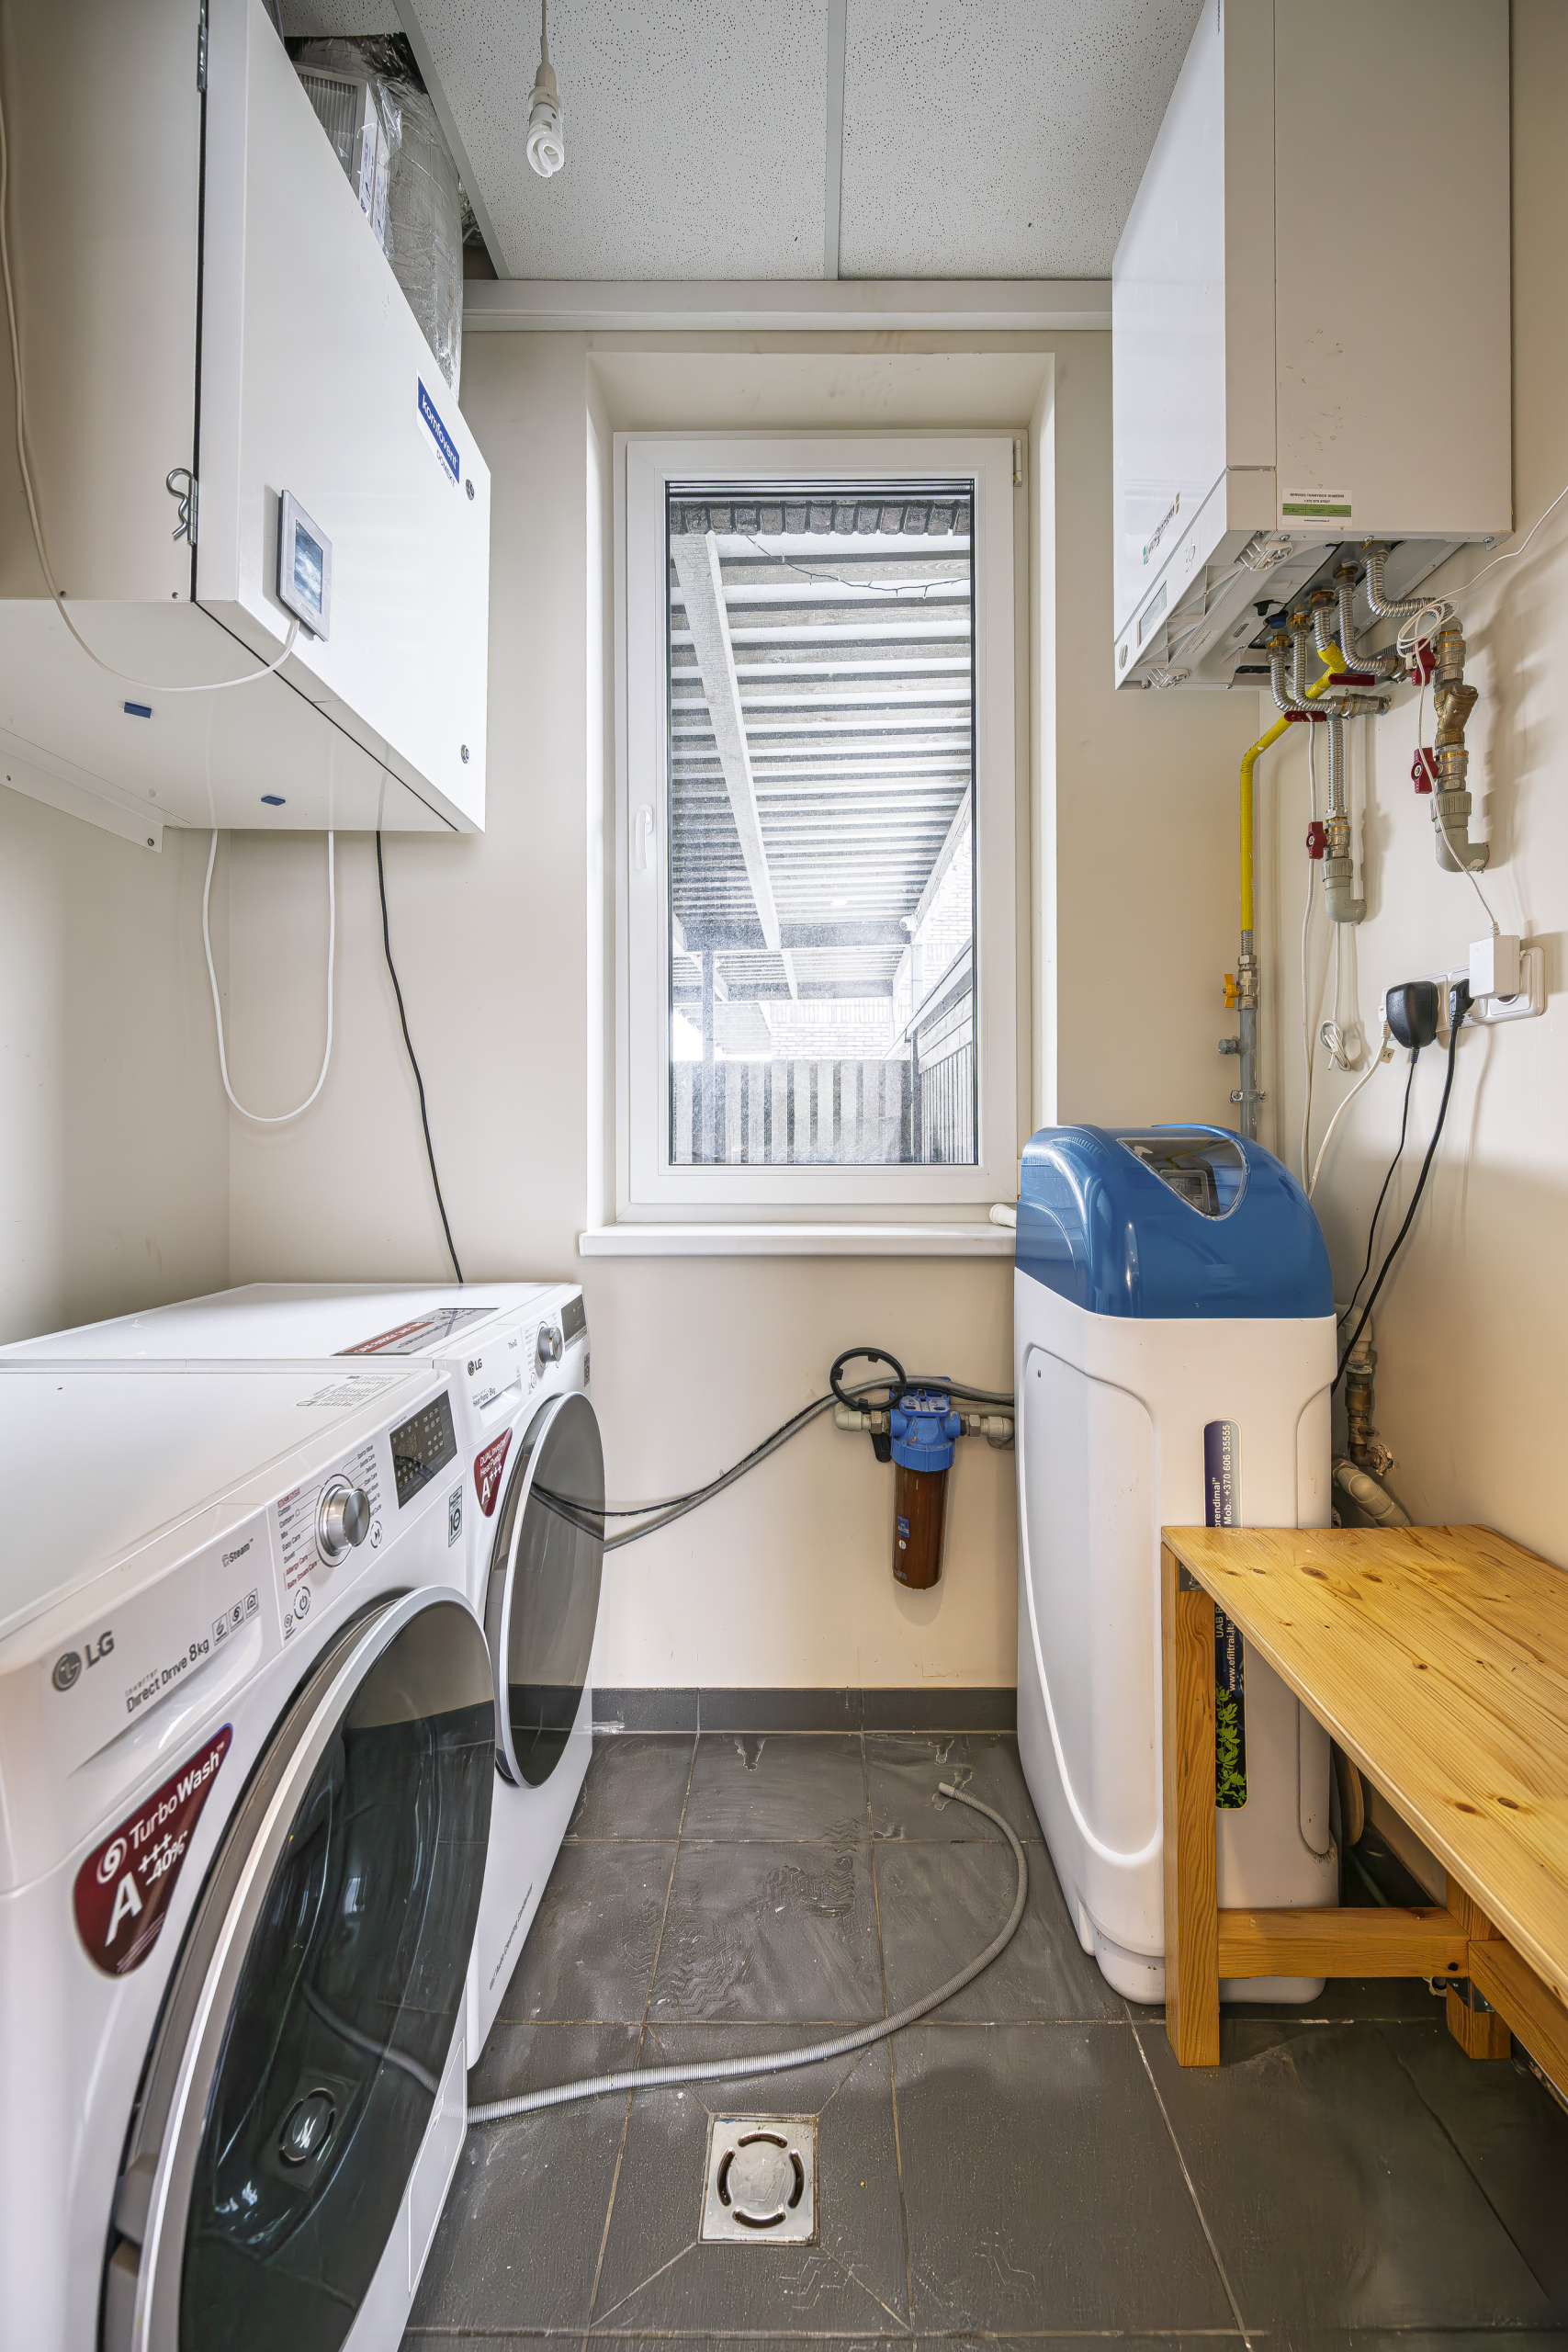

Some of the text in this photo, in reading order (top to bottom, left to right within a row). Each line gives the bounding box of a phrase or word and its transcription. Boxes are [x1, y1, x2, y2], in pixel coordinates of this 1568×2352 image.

[422, 393, 457, 470] komfovent
[474, 1358, 483, 1371] LG
[1222, 1424, 1233, 1525] Mob.: +370 606 35555
[85, 1630, 115, 1670] LG
[1215, 1616, 1224, 1638] UAB
[126, 1638, 209, 1713] Direct Drive 8kg
